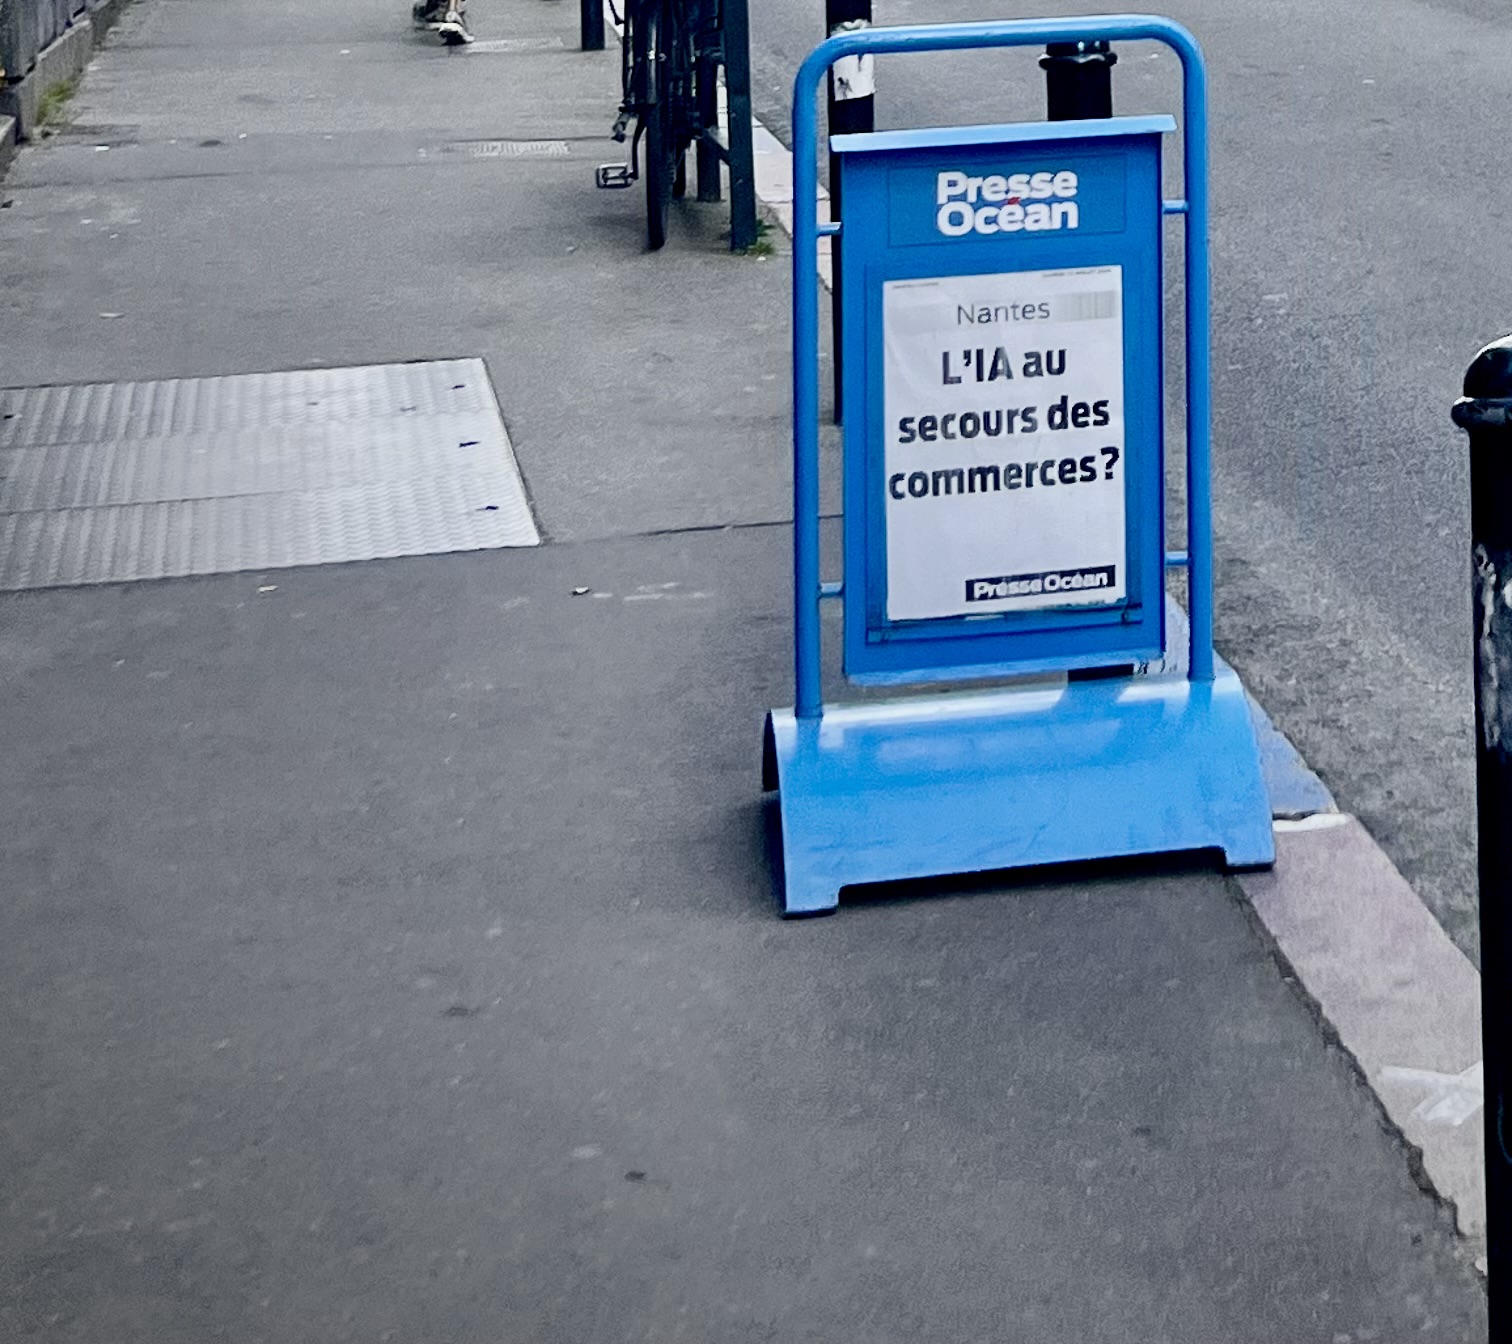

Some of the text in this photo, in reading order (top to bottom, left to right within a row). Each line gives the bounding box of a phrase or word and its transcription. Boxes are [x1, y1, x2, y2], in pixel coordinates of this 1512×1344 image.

[937, 170, 1078, 204] Presse
[937, 196, 1079, 236] Océan
[957, 301, 1051, 325] Nantes
[942, 346, 1067, 385] L'IA au
[898, 395, 1110, 444] secours des
